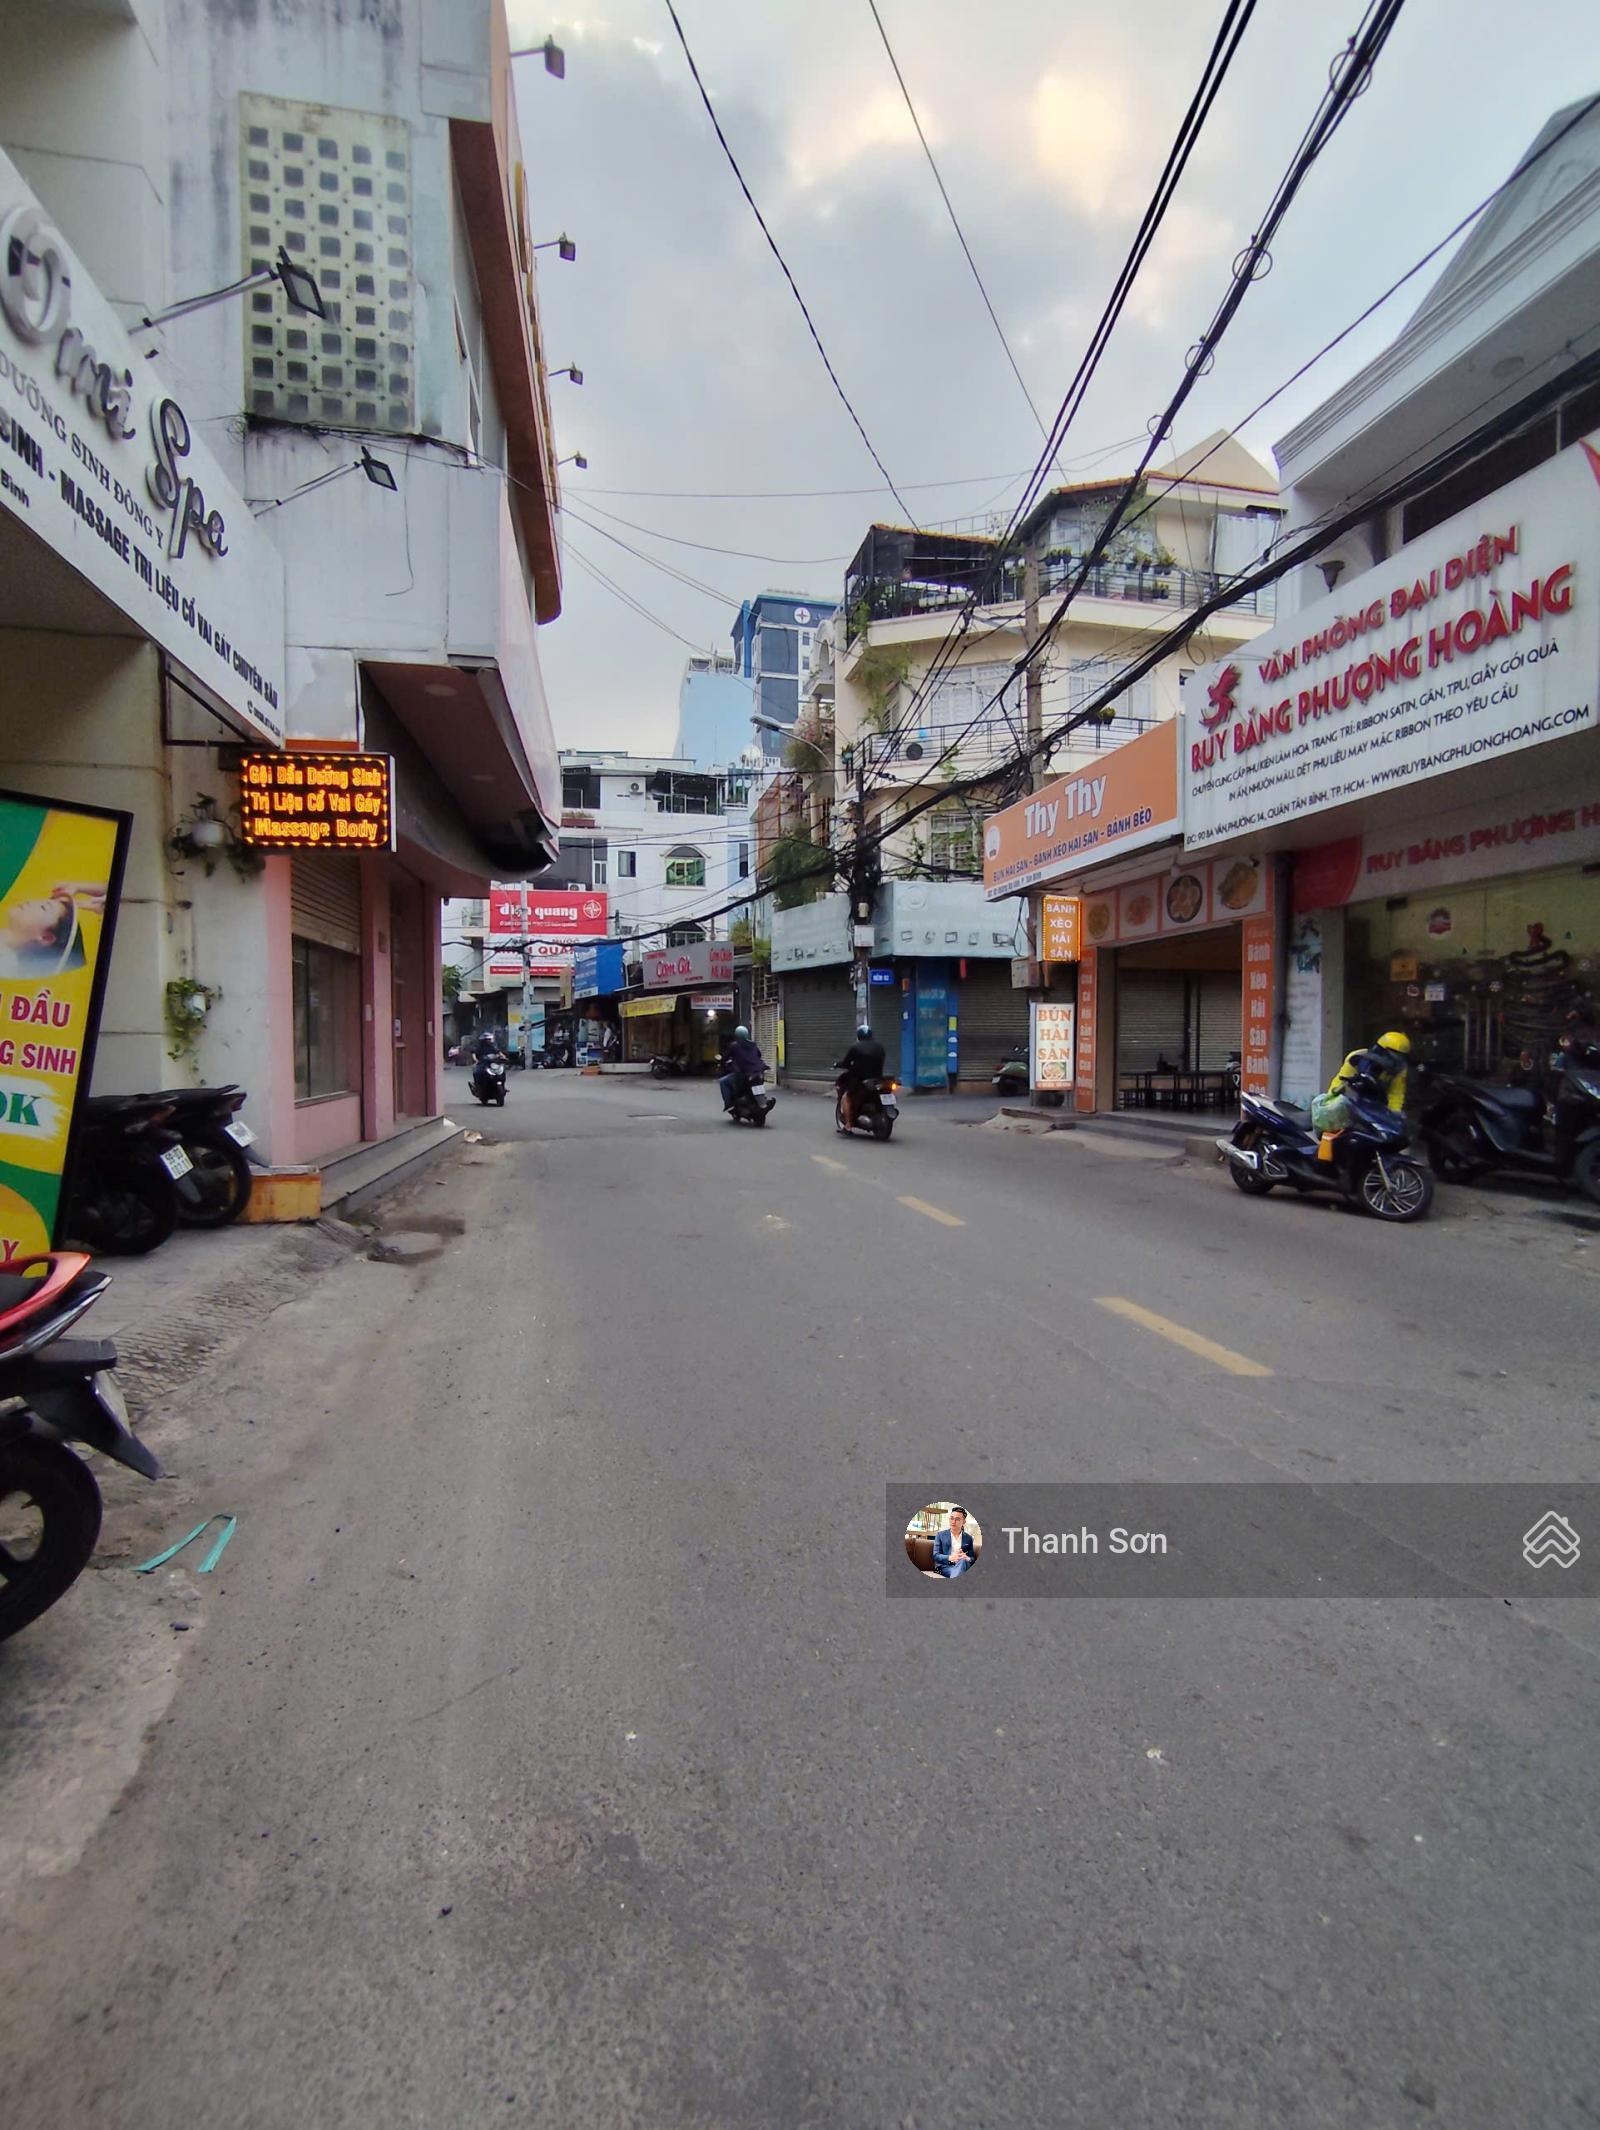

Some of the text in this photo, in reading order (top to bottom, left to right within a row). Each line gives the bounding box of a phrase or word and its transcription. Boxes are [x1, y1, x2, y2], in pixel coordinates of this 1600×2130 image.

[71, 432, 111, 492] SINH
[113, 479, 153, 538] ĐÔNG
[155, 526, 164, 549] Y
[147, 397, 230, 561] Spa
[60, 469, 130, 565] MASSAGE
[133, 545, 153, 592] TRỊ
[155, 567, 180, 613] LIỆU
[198, 612, 213, 648] VAI
[214, 631, 232, 665] GÁY
[233, 650, 263, 696] CHUYÊN
[264, 681, 279, 711] SÂU
[1259, 524, 1520, 685] VĂN PHÒNG ĐẠI DIỆN
[1191, 562, 1575, 774] RUY BĂNG PHƯỢNG HOÀNG
[1214, 773, 1233, 789] CUNG
[1292, 742, 1310, 759] HOA
[1311, 729, 1338, 749] TRANG
[1356, 710, 1388, 733] RIBBON
[1500, 651, 1525, 674] GÓI
[1228, 789, 1236, 802] IN
[1347, 740, 1369, 758] MAY
[1395, 717, 1431, 741] RIBBON
[1434, 706, 1463, 727] THEO
[1466, 695, 1488, 715] YÊU
[249, 764, 273, 788] Gội
[351, 767, 382, 787] Sinh
[251, 791, 270, 814] Trị
[273, 791, 303, 815] Liệu
[328, 793, 351, 812] Vai
[354, 792, 382, 816] Gáy
[1024, 775, 1107, 839] Thy Thy
[1291, 795, 1308, 812] TÂN
[254, 817, 378, 841] Massage Body
[1106, 815, 1132, 838] BÁNH
[1132, 804, 1153, 829] BÈO
[1366, 848, 1405, 875] RUY
[1468, 808, 1577, 853] PHƯỢNG
[534, 906, 578, 921] quang
[1046, 899, 1076, 913] BÁNH
[1050, 915, 1073, 928] XÈO
[1051, 930, 1071, 944] HẢI
[1050, 945, 1072, 958] SẢN
[1247, 943, 1270, 962] Bánh
[11, 988, 71, 1028] ĐẦU
[1037, 1006, 1072, 1022] BÚN
[1251, 996, 1266, 1018] Hải
[1039, 1023, 1070, 1041] HẢI
[1249, 1024, 1266, 1047] Sản
[21, 1043, 77, 1075] SINH
[1037, 1042, 1071, 1061] SẢN
[1246, 1053, 1269, 1074] Bánh
